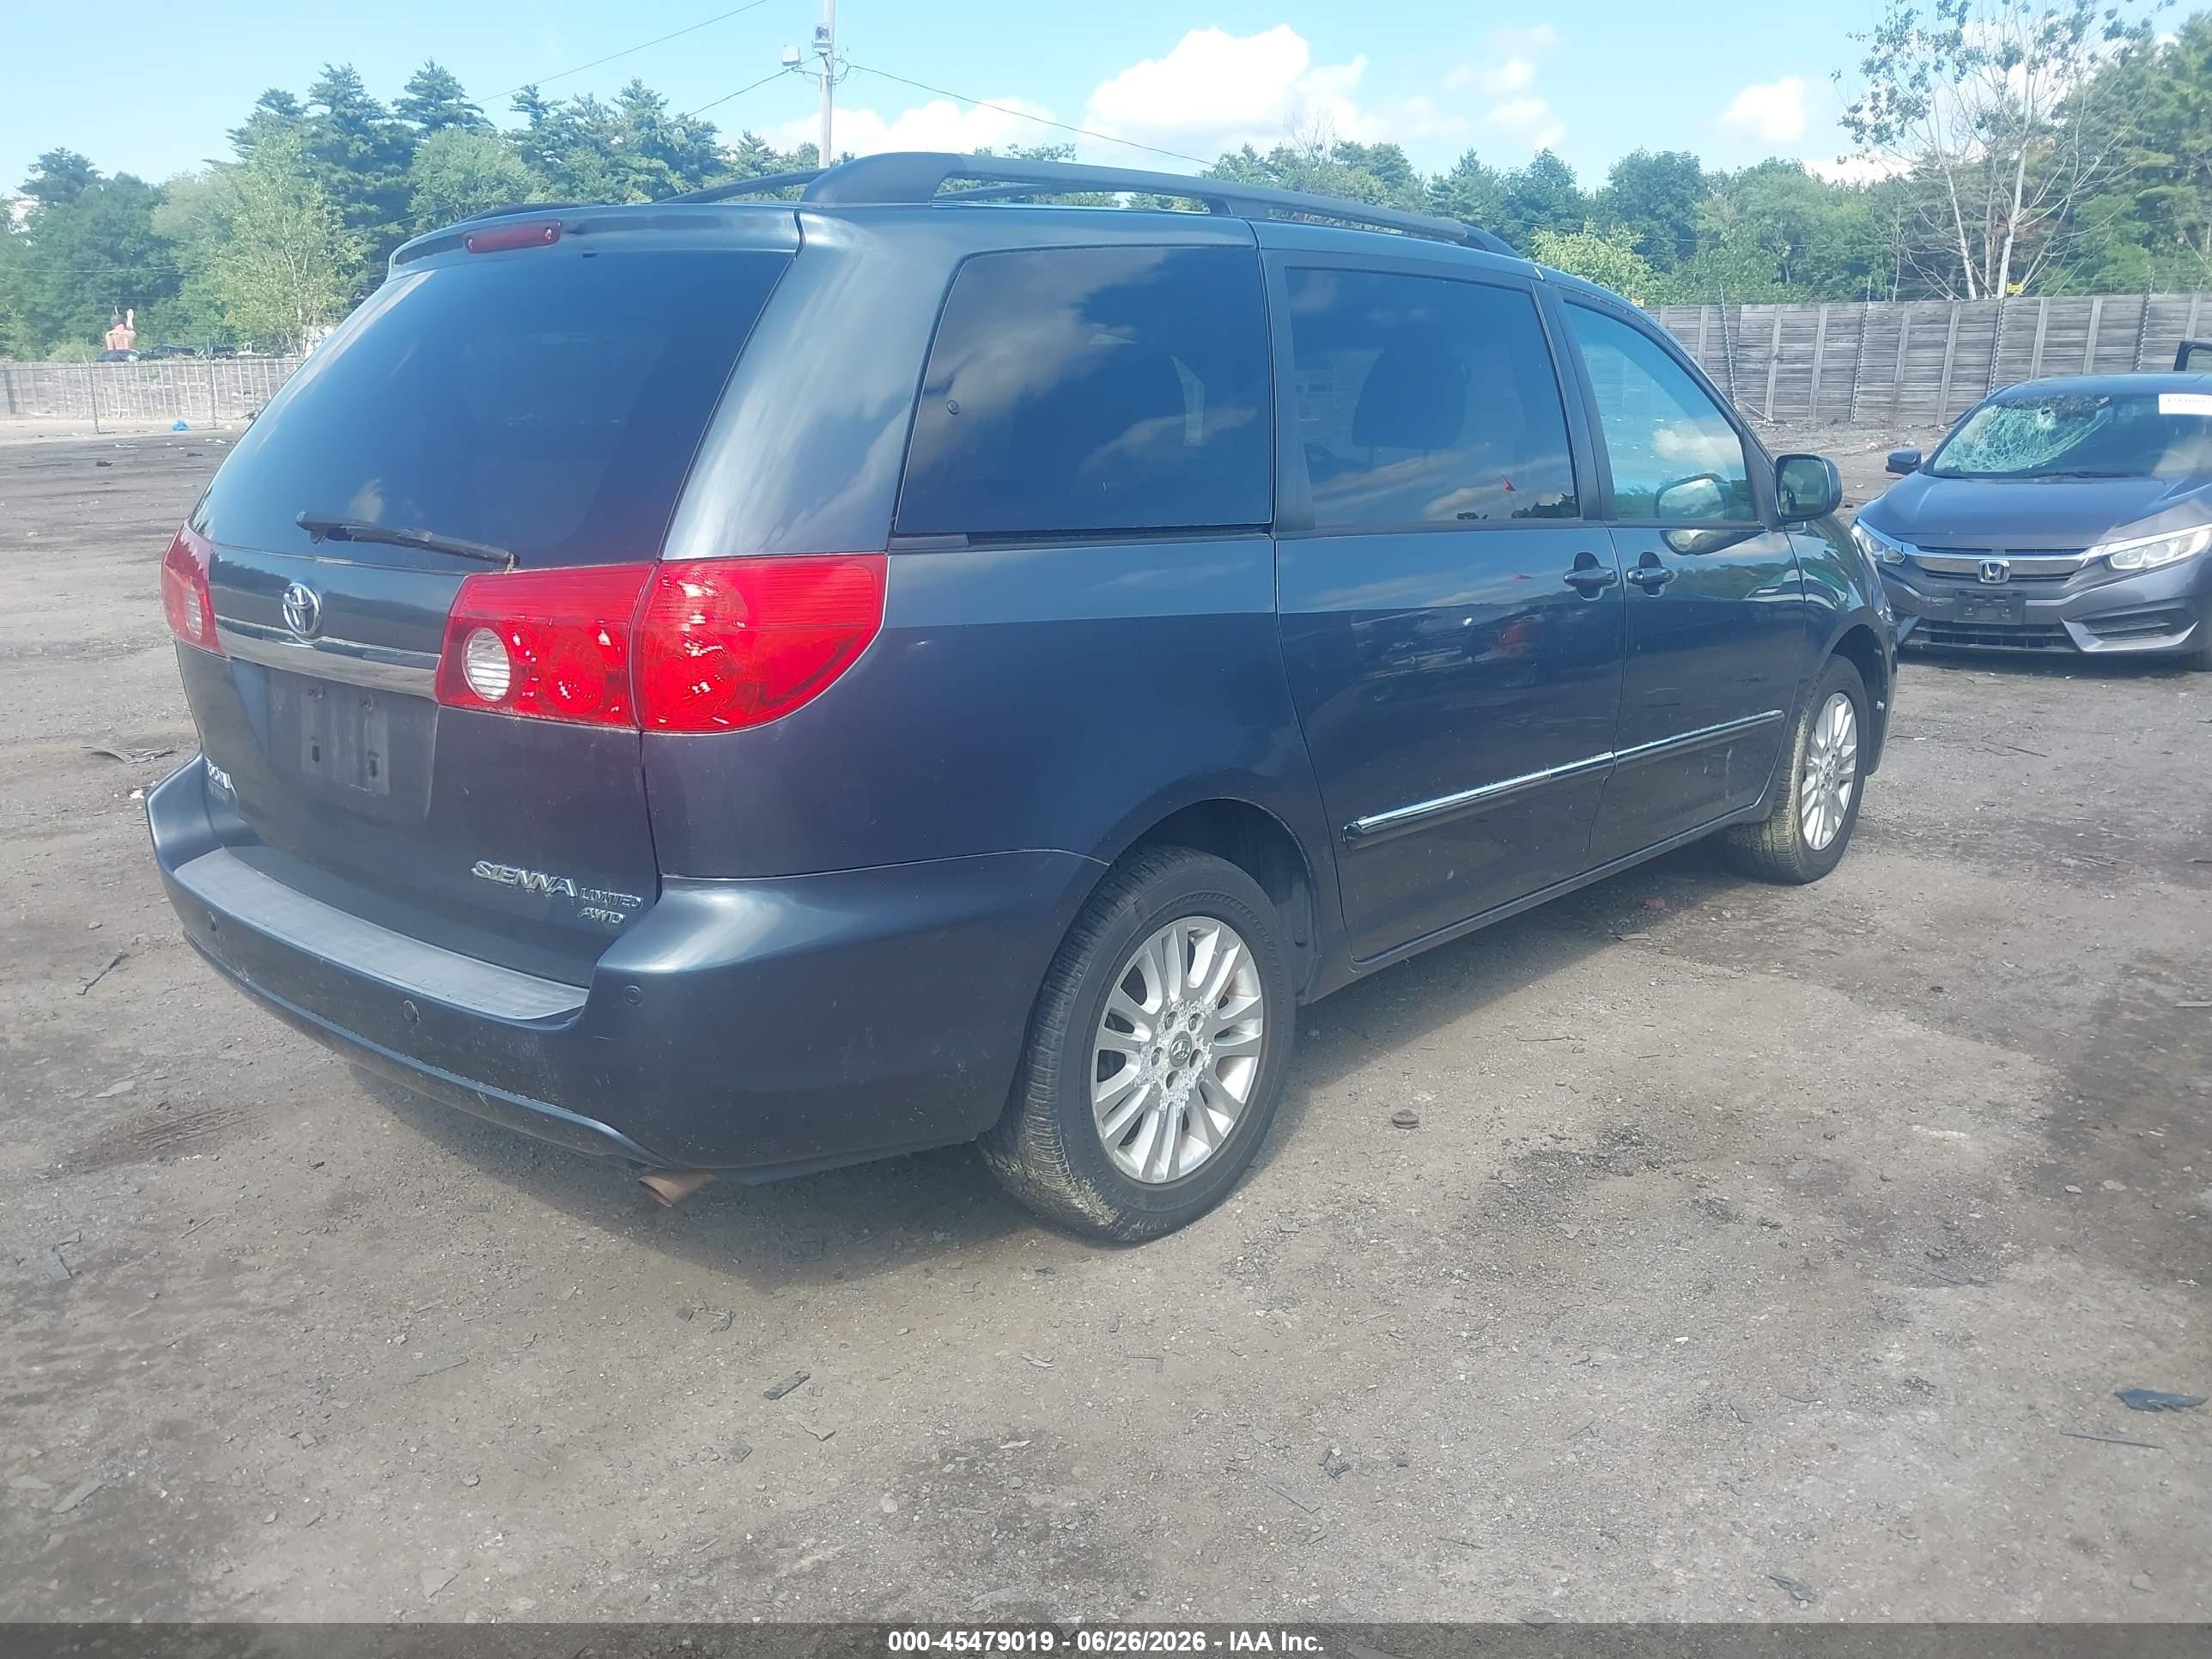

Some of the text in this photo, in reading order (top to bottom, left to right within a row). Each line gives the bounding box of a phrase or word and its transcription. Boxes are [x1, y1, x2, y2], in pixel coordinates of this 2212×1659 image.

[471, 860, 643, 908] SIENNA LIMITED
[577, 906, 625, 925] AWD
